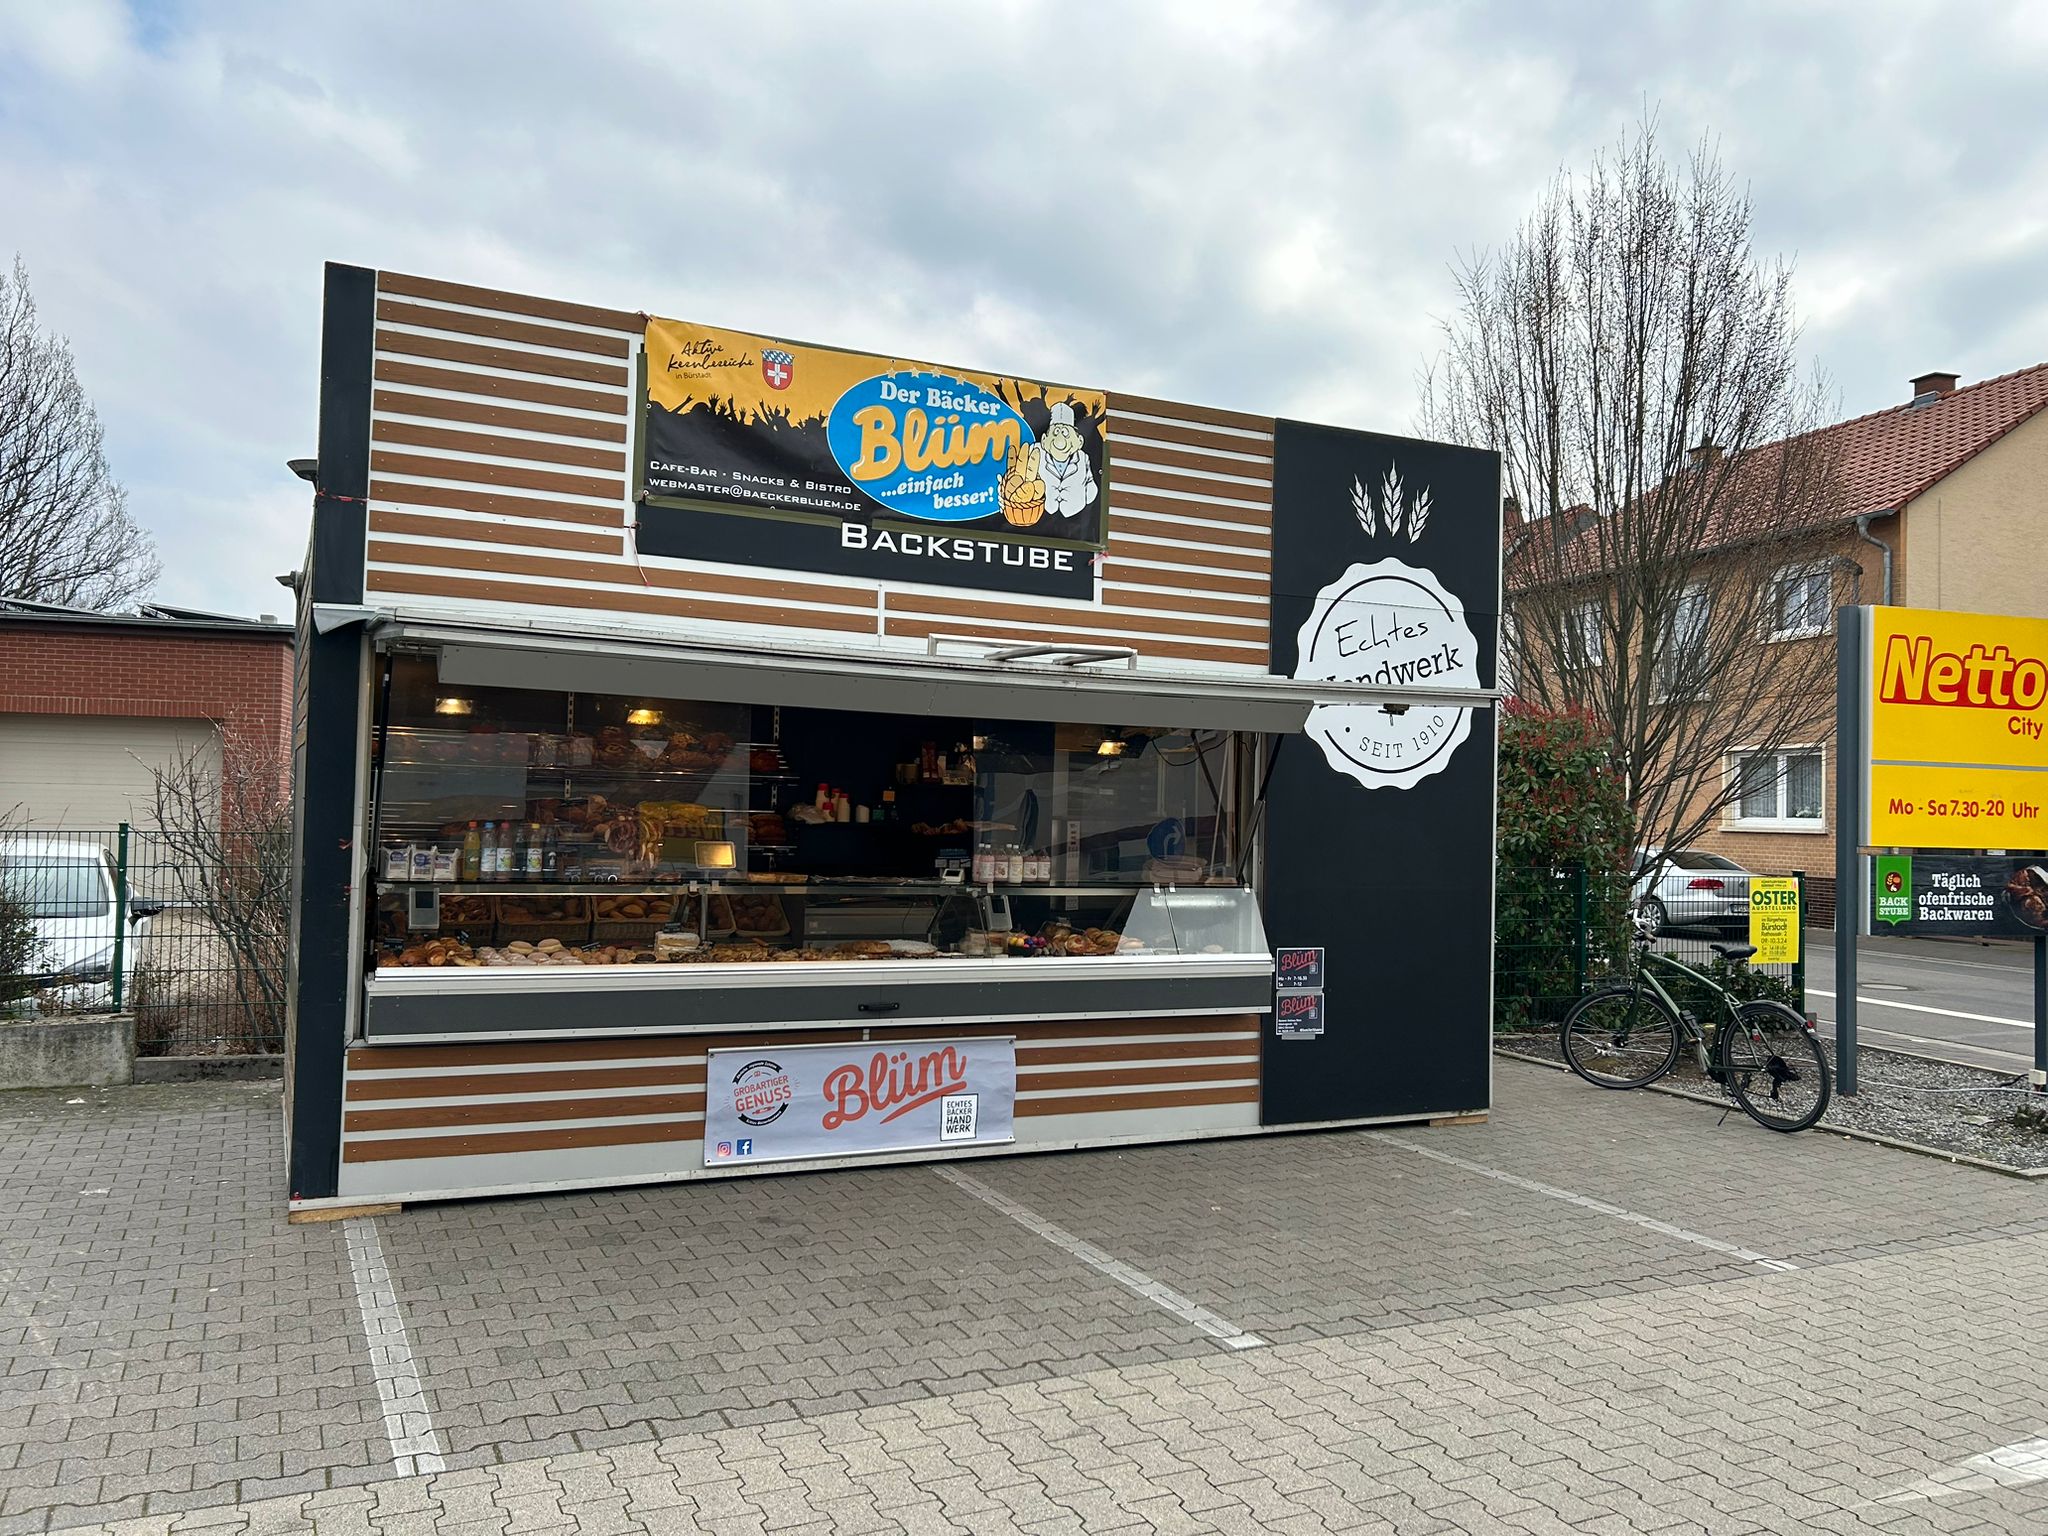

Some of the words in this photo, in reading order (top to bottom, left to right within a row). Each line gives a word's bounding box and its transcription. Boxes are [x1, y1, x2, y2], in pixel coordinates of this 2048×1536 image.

[879, 380, 921, 402] Der
[926, 387, 1001, 415] Bäcker
[850, 404, 1022, 481] Blüm
[732, 471, 785, 487] SNACKS
[789, 479, 800, 489] &
[805, 480, 852, 495] BISTRO
[933, 486, 994, 510] besser!
[840, 522, 1074, 573] BACKSTUBE
[1335, 612, 1429, 658] Echtes
[1880, 633, 2047, 712] Netto
[1359, 736, 1403, 759] SEIT
[1412, 714, 1445, 752] 1910
[2007, 716, 2043, 740] City
[1889, 798, 1914, 816] Mo
[1927, 799, 1947, 817] Sa
[2012, 802, 2040, 819] Uhr
[1932, 873, 1981, 891] Täglich
[1752, 890, 1797, 905] OSTER
[1879, 897, 1909, 906] BACK
[1918, 892, 1994, 906] ofenfrische
[1879, 908, 1909, 916] STUBE
[1919, 907, 1994, 921] Backwaren
[1281, 950, 1318, 971] Blüm
[1281, 995, 1317, 1016] Blüm
[735, 1085, 792, 1112] GENUSS
[822, 1046, 966, 1130] Blüm
[946, 1100, 973, 1109] ECHTES
[946, 1115, 972, 1125] HAND
[946, 1124, 971, 1134] WERK
